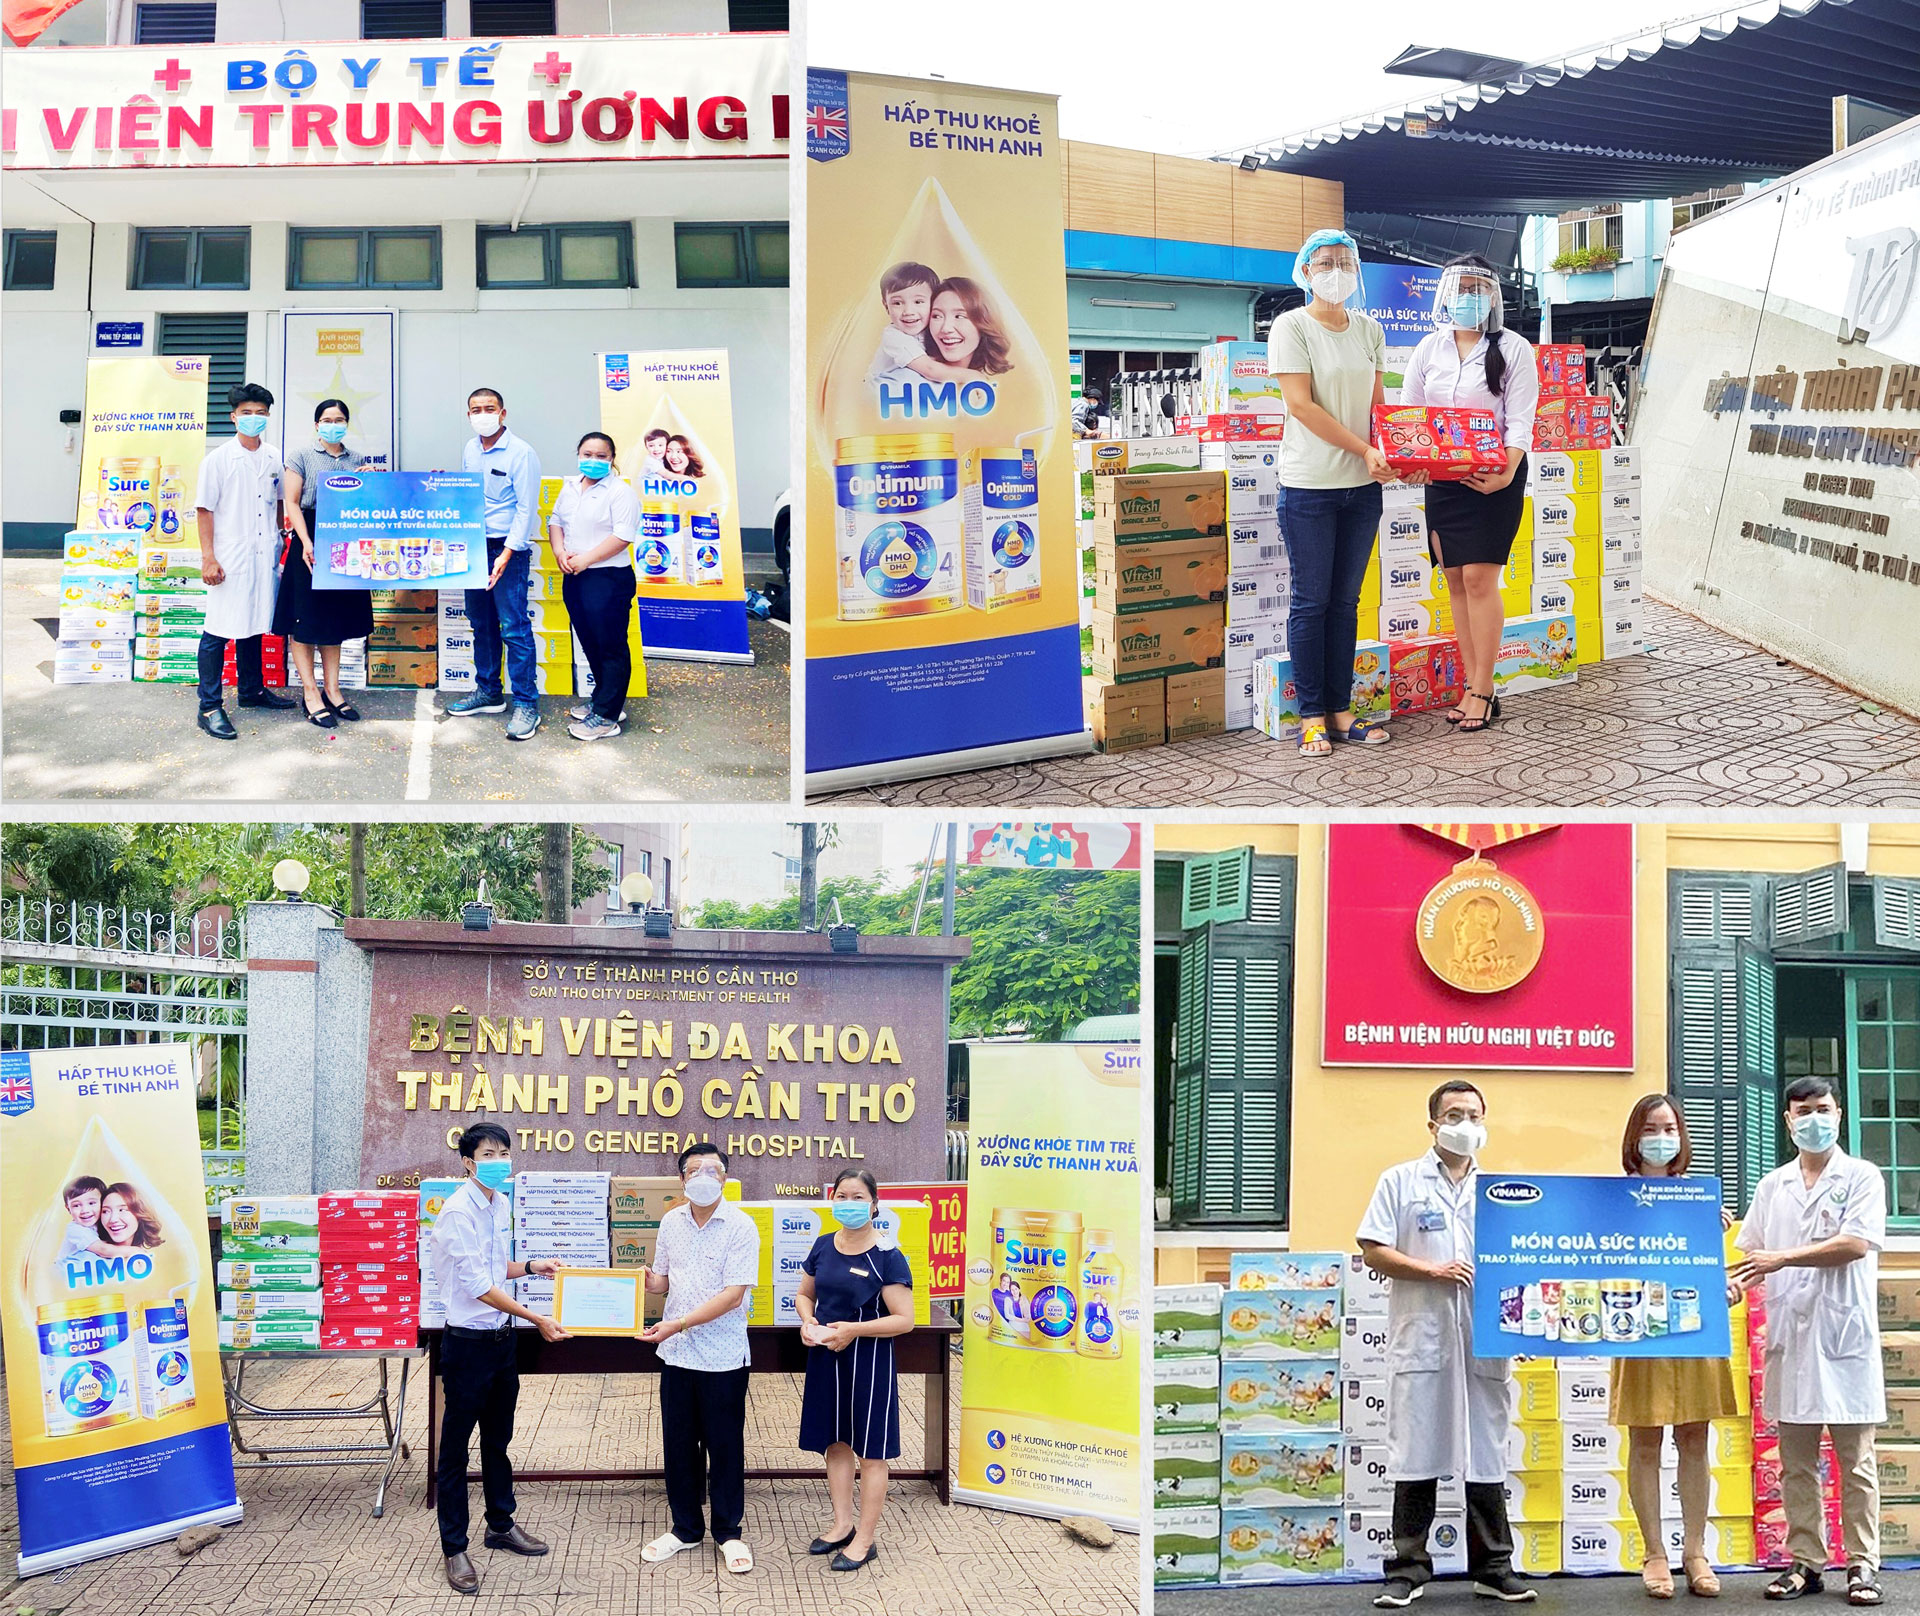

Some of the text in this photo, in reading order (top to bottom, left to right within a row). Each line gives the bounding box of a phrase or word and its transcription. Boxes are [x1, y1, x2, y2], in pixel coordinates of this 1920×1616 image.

[226, 42, 502, 98] BỘ Y TẾ
[41, 94, 213, 162] VIỆN
[239, 101, 502, 149] TRUNG
[528, 89, 749, 146] ƯƠNG
[884, 100, 1041, 135] HẤP THU KHOẺ
[909, 128, 1042, 157] BÉ TINH ANH
[1370, 306, 1394, 319] QUÀ
[1397, 308, 1418, 320] SỨC
[176, 360, 202, 370] Sure
[690, 361, 718, 370] KHOẺ
[656, 372, 668, 381] BÉ
[880, 381, 995, 420] HMO
[1469, 418, 1495, 431] HERO
[1814, 426, 1865, 462] CITY
[1231, 453, 1257, 461] Optimum
[1614, 455, 1630, 464] Sure
[1540, 465, 1565, 477] Sure
[644, 479, 697, 496] HMO
[849, 474, 944, 500] Optimum
[986, 481, 1035, 498] Optimum
[1232, 477, 1257, 488] Sure
[876, 495, 917, 508] GOLD
[1002, 493, 1021, 501] GOLD
[1614, 496, 1630, 505] Sure
[341, 508, 460, 520] MÓN QUÀ SỨC KHỎE
[1120, 498, 1160, 515] Vfresh
[1233, 529, 1258, 540] Sure
[885, 552, 954, 577] HMO 4
[1122, 567, 1162, 584] Vfresh
[1123, 586, 1145, 594] ORANGE
[1120, 634, 1161, 652] Vfresh
[1423, 876, 1536, 938] HUÂN CHƯƠNG HỒ CHÍ MINH
[521, 960, 799, 986] SỞ Y TẾ THÀNH PHỐ CẦN THƠ
[529, 986, 791, 1003] CAN THO CITY DEPARTMENT OF HEALTH
[409, 1004, 903, 1069] BỆNH VIỆN ĐA KHOA
[1345, 1022, 1615, 1049] BỆNH VIỆN HỮU NGHỊ VIỆT ĐỨC
[59, 1058, 177, 1081] HẤP THU KHOẺ
[78, 1080, 180, 1096] BÉ TINH ANH
[396, 1062, 916, 1123] THÀNH PHỐ CẦN THƠ
[516, 1128, 575, 1152] THO
[727, 1133, 865, 1159] HOSPITAL
[977, 1135, 1136, 1154] XƯƠNG KHỎE TIM TRẺ
[980, 1151, 1140, 1173] ĐẦY SỨC THANH XUÂ
[775, 1183, 821, 1197] Website
[939, 1193, 962, 1221] TÔ
[233, 1221, 260, 1231] FARM
[1512, 1232, 1687, 1250] MÓN QUÀ SỨC KHỎE
[1005, 1239, 1067, 1268] Sure
[1479, 1254, 1507, 1263] TRAO
[1540, 1253, 1562, 1264] CÁN
[1565, 1255, 1580, 1266] BỘ
[1582, 1255, 1589, 1264] Y
[1590, 1253, 1603, 1264] TẾ
[1605, 1254, 1637, 1265] TUYẾN
[67, 1253, 153, 1289] HMO
[968, 1266, 994, 1275] COLLAGEN
[1005, 1264, 1034, 1274] Prevent
[973, 1311, 991, 1322] CANXI
[1011, 1433, 1128, 1458] HỆ XƯƠNG KHỚP CHẮC KHOẺ
[1011, 1467, 1092, 1489] TỐT CHO TIM MẠCH
